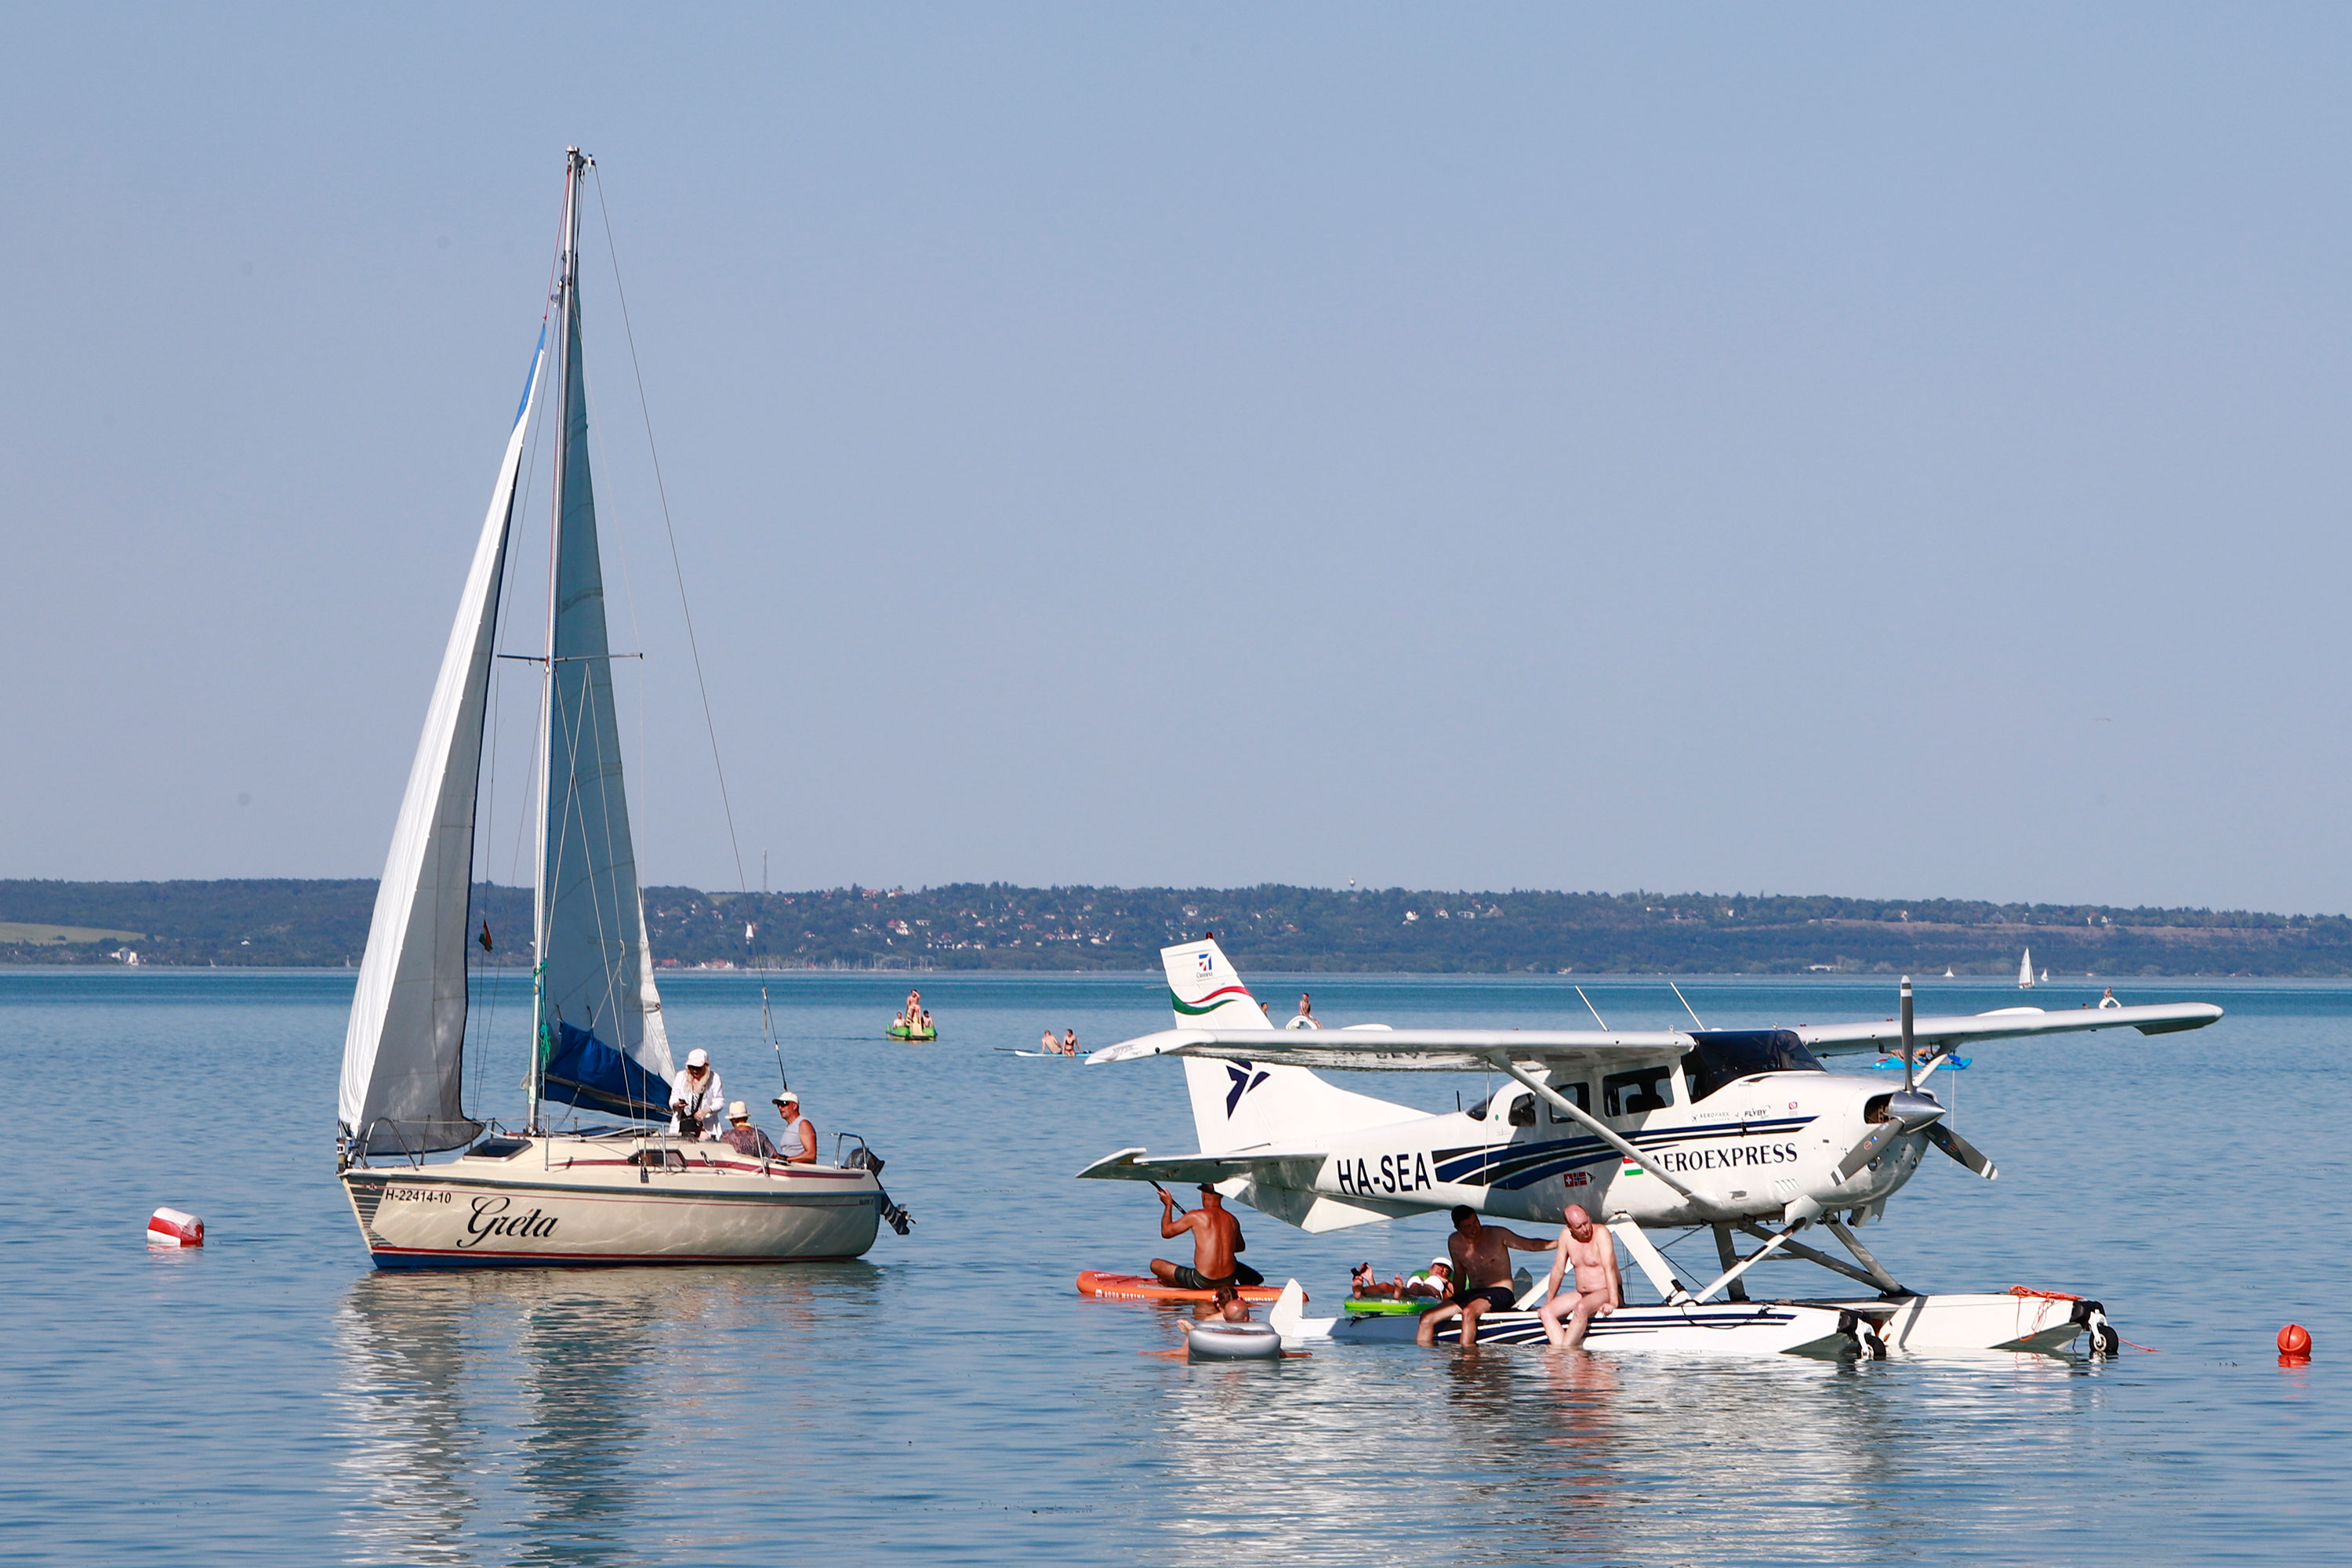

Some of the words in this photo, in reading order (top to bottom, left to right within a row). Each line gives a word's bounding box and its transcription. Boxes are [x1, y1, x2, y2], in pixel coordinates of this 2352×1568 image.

[385, 1189, 452, 1203] H-22414-10
[1337, 1152, 1432, 1196] HA-SEA
[456, 1196, 559, 1248] Gréta
